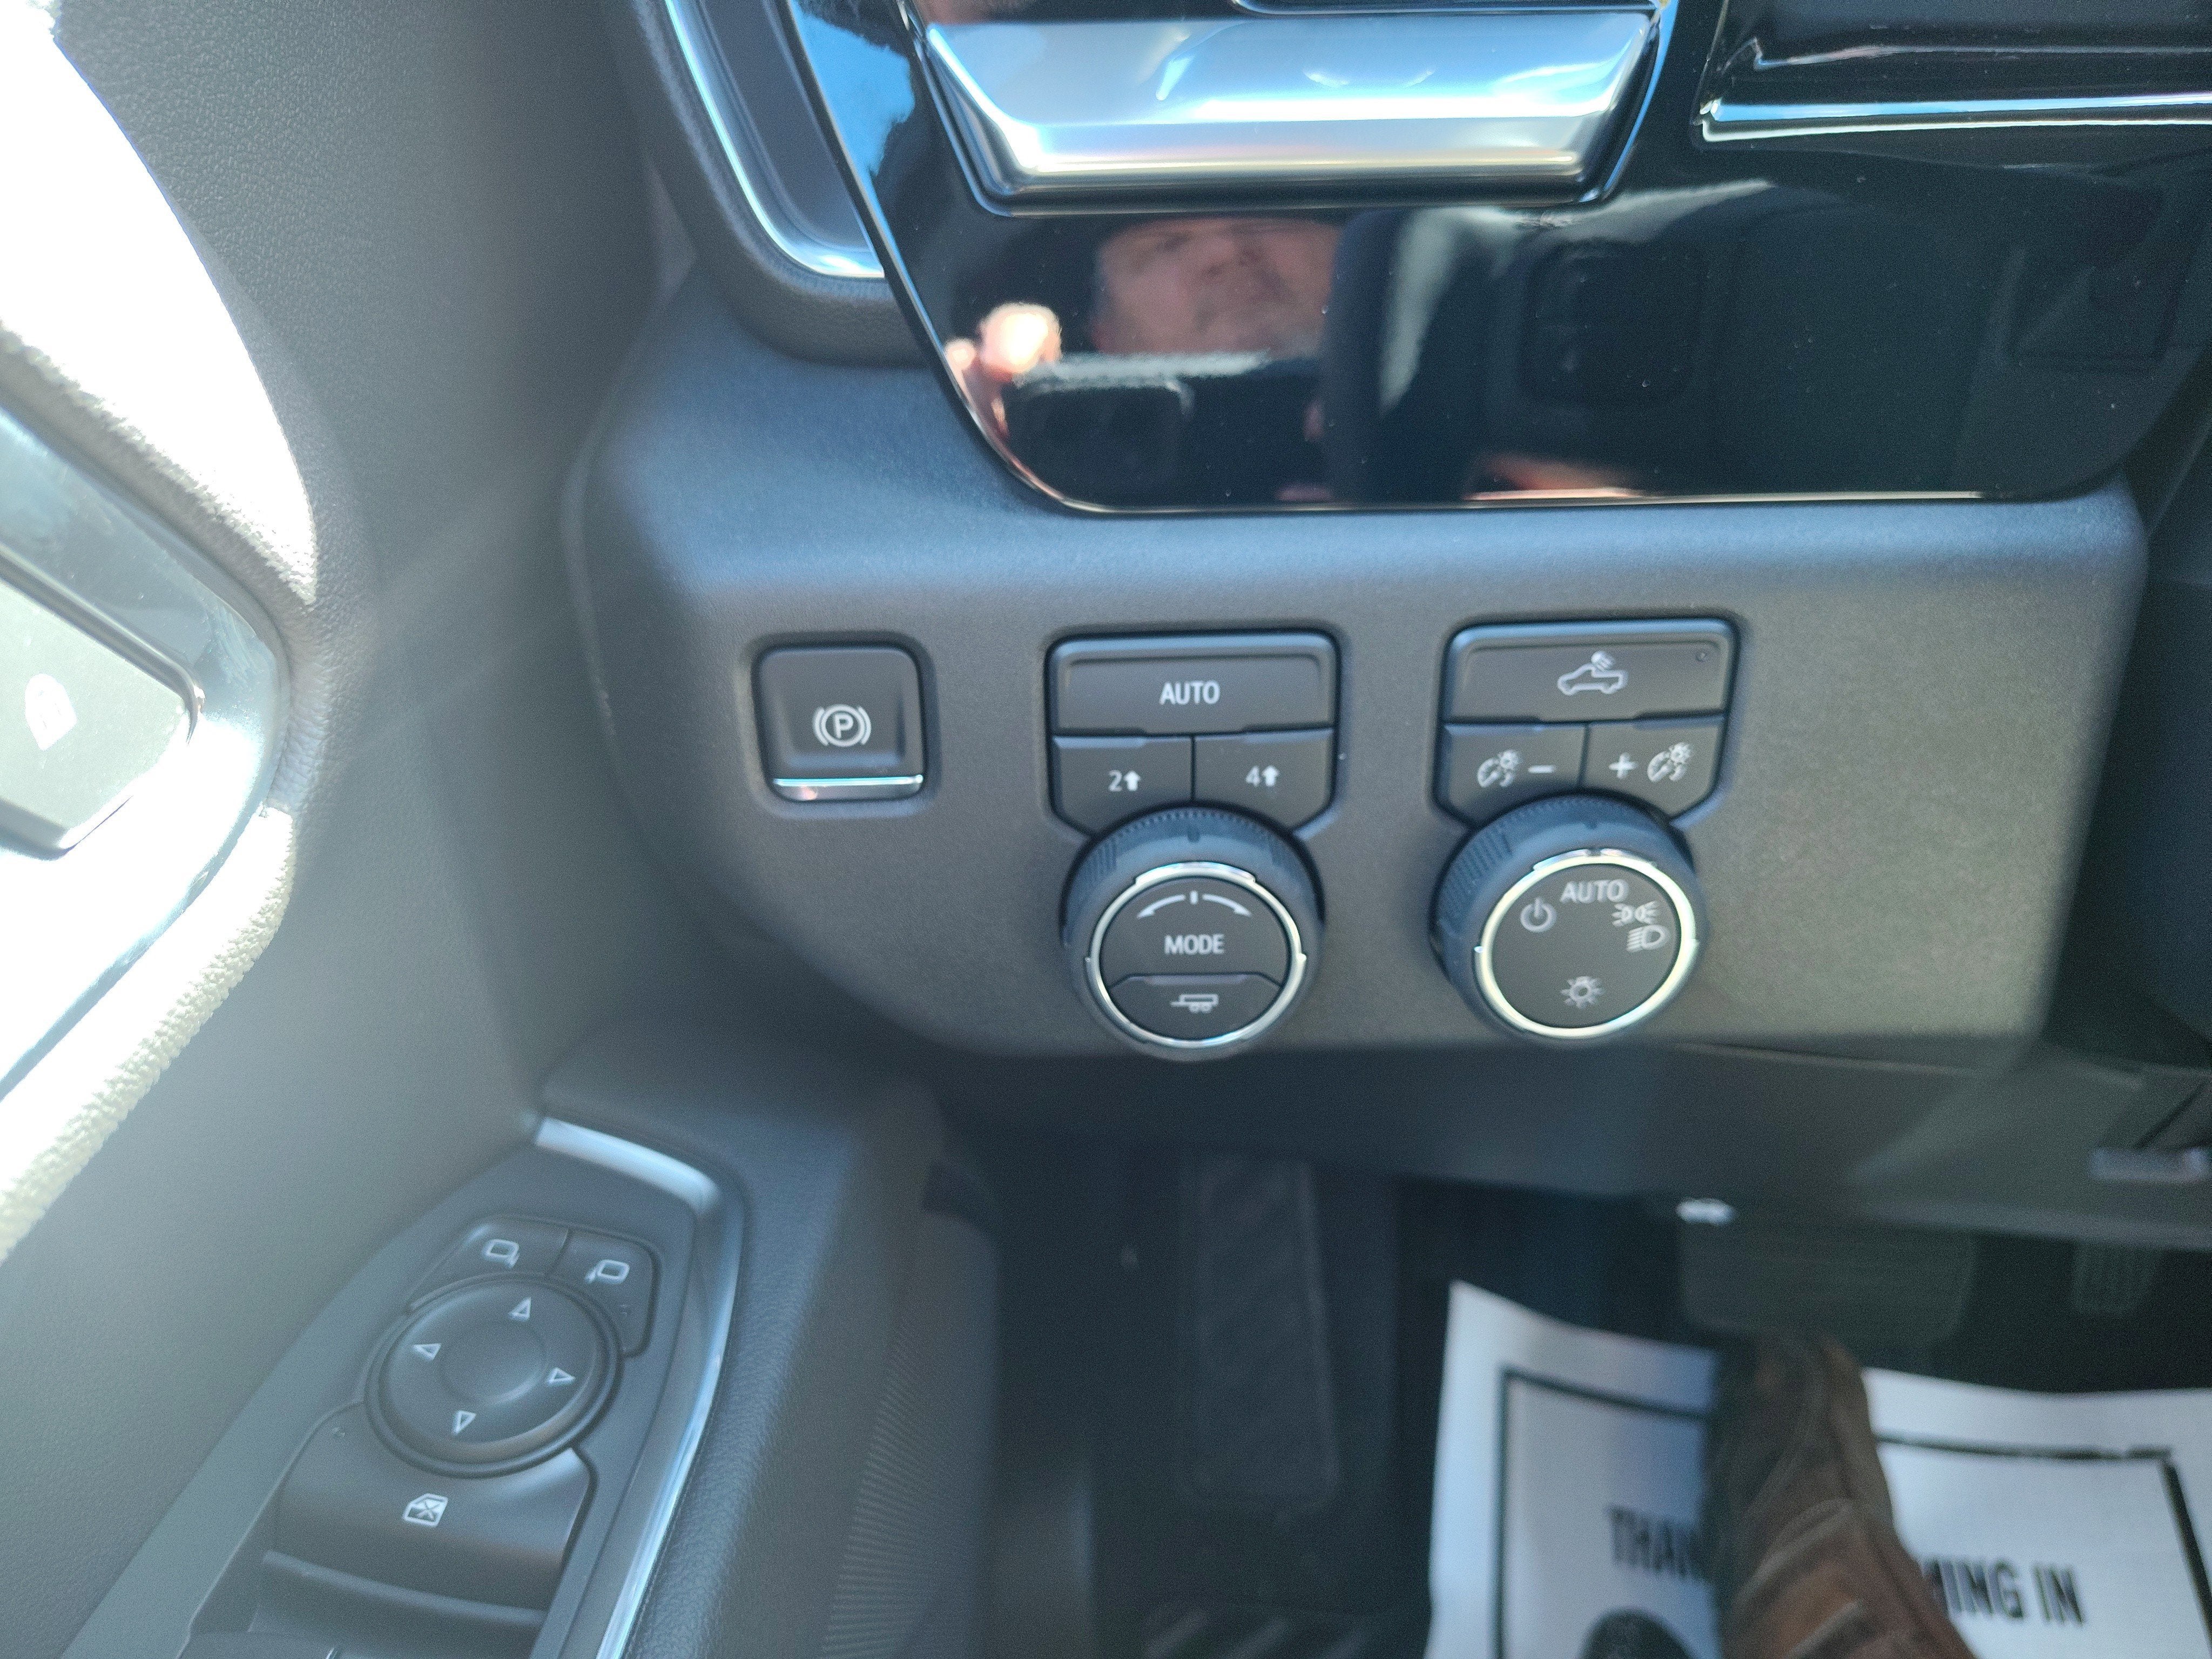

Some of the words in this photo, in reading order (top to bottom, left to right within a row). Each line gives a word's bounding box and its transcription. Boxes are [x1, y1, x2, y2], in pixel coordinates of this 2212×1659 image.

[1159, 681, 1220, 704] AUTO
[1560, 880, 1628, 903] AUTO
[1164, 934, 1224, 954] MODE
[2033, 1564, 2085, 1624] IN
